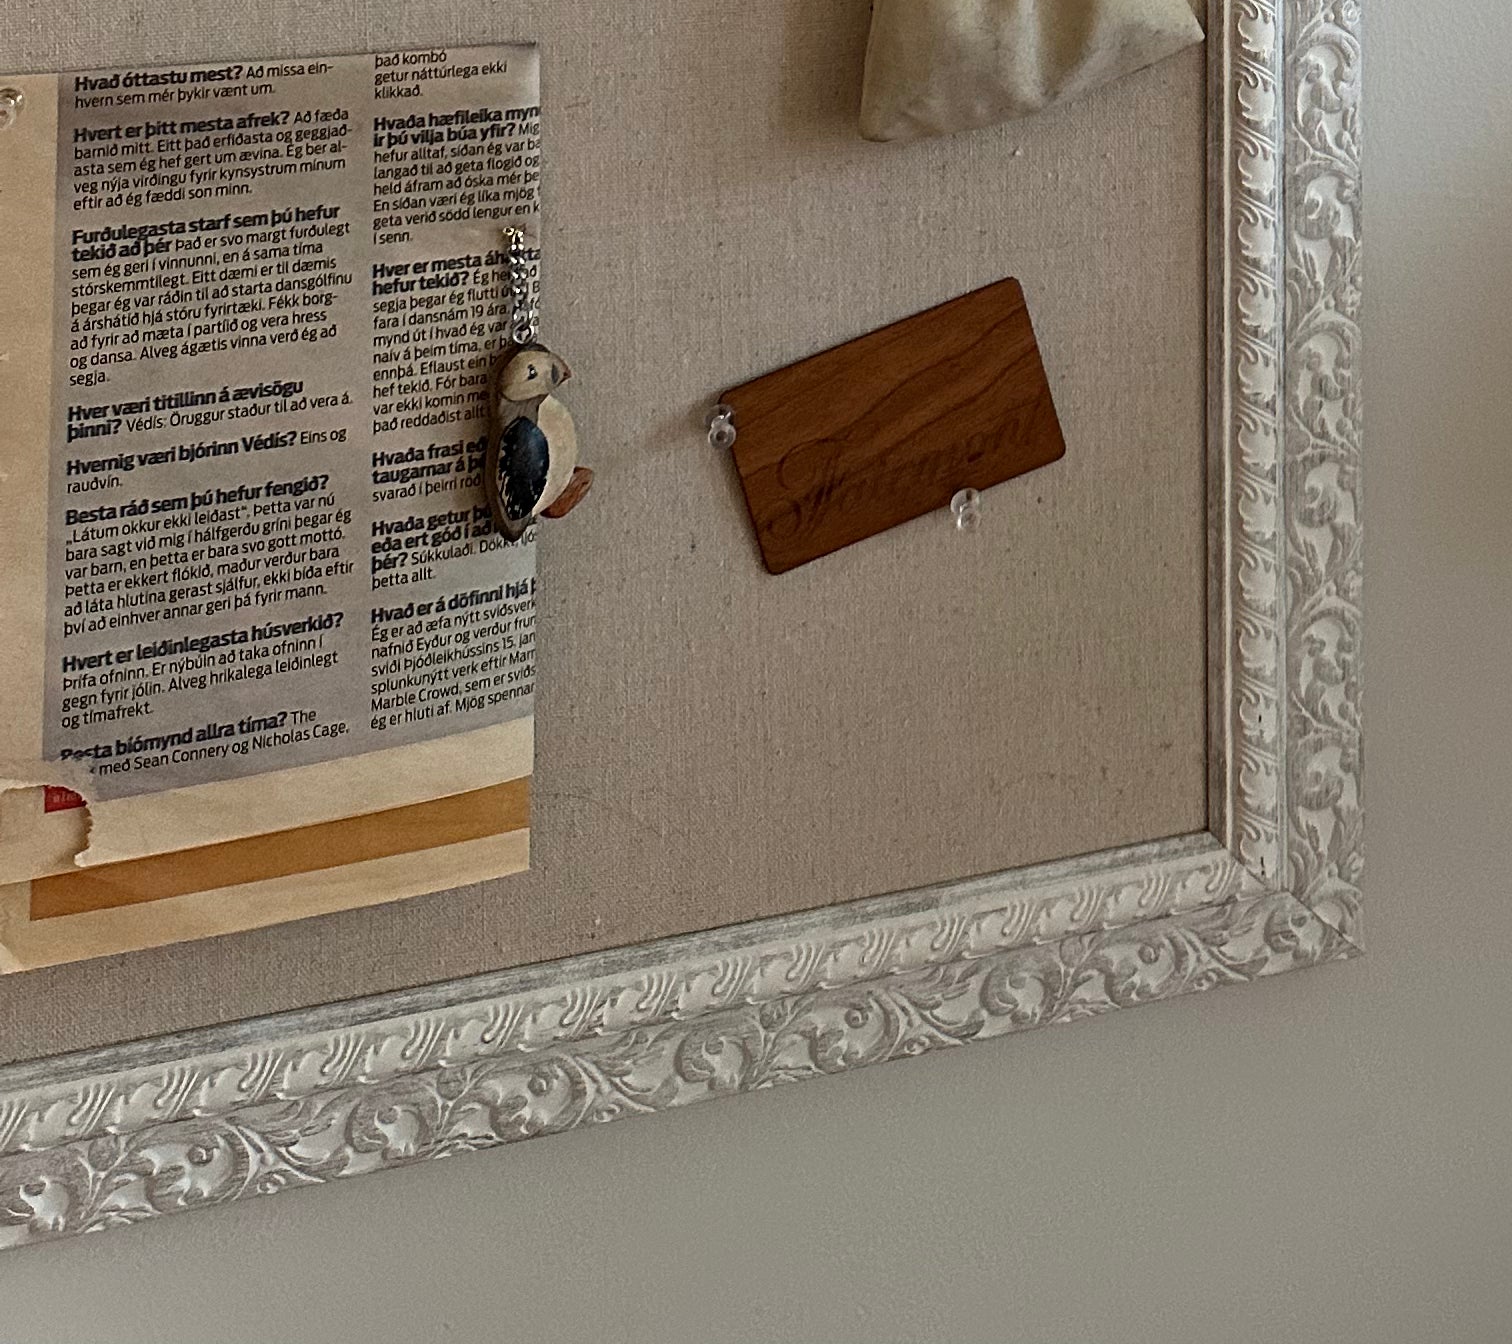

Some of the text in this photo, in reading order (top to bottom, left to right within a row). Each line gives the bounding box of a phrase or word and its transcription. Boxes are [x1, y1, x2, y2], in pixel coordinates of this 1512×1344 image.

[74, 61, 334, 92] Hvað óttastu mest? Að missa ein-
[373, 69, 409, 86] getur
[480, 59, 507, 75] ekki
[74, 83, 275, 109] hvern sem mér þykir vænt um.
[374, 83, 423, 99] klikkað.
[72, 124, 123, 143] Hvert
[124, 125, 143, 138] er
[144, 120, 177, 140] þitt
[178, 116, 234, 134] mesta
[235, 109, 290, 129] afrek?
[292, 109, 312, 124] Að
[372, 121, 516, 149] ir þú vilja búa yfir?
[373, 113, 426, 131] Hvaða
[71, 203, 340, 245] Furðulegasta starf sem þú hefur
[117, 237, 142, 257] að
[142, 236, 173, 258] þér
[174, 235, 201, 252] Það
[203, 236, 218, 249] er
[219, 233, 243, 247] svo
[245, 227, 287, 244] margt
[67, 404, 110, 422] Hver
[110, 395, 151, 416] væri
[231, 379, 303, 401] ævisögu
[66, 452, 135, 476] Hvernig
[135, 445, 176, 466] væri
[240, 430, 297, 452] Védís?
[299, 430, 327, 445] Eins
[329, 427, 347, 442] og
[65, 505, 117, 525] Besta
[119, 498, 149, 518] ráð
[150, 496, 188, 514] sem
[189, 488, 213, 511] þú
[215, 484, 263, 505] hefur
[370, 601, 414, 624] Hvað
[415, 601, 434, 616] er
[504, 579, 528, 600] hjá
[61, 649, 113, 673] Hvert
[114, 648, 134, 664] er
[370, 691, 416, 712] Marble
[464, 676, 491, 693] sem
[492, 673, 506, 686] er
[114, 709, 316, 756] bíómynd allra tíma? The
[98, 757, 131, 776] með
[133, 754, 169, 770] Sean
[171, 743, 230, 763] Connery
[231, 739, 249, 755] og
[251, 728, 310, 750] Nicholas
